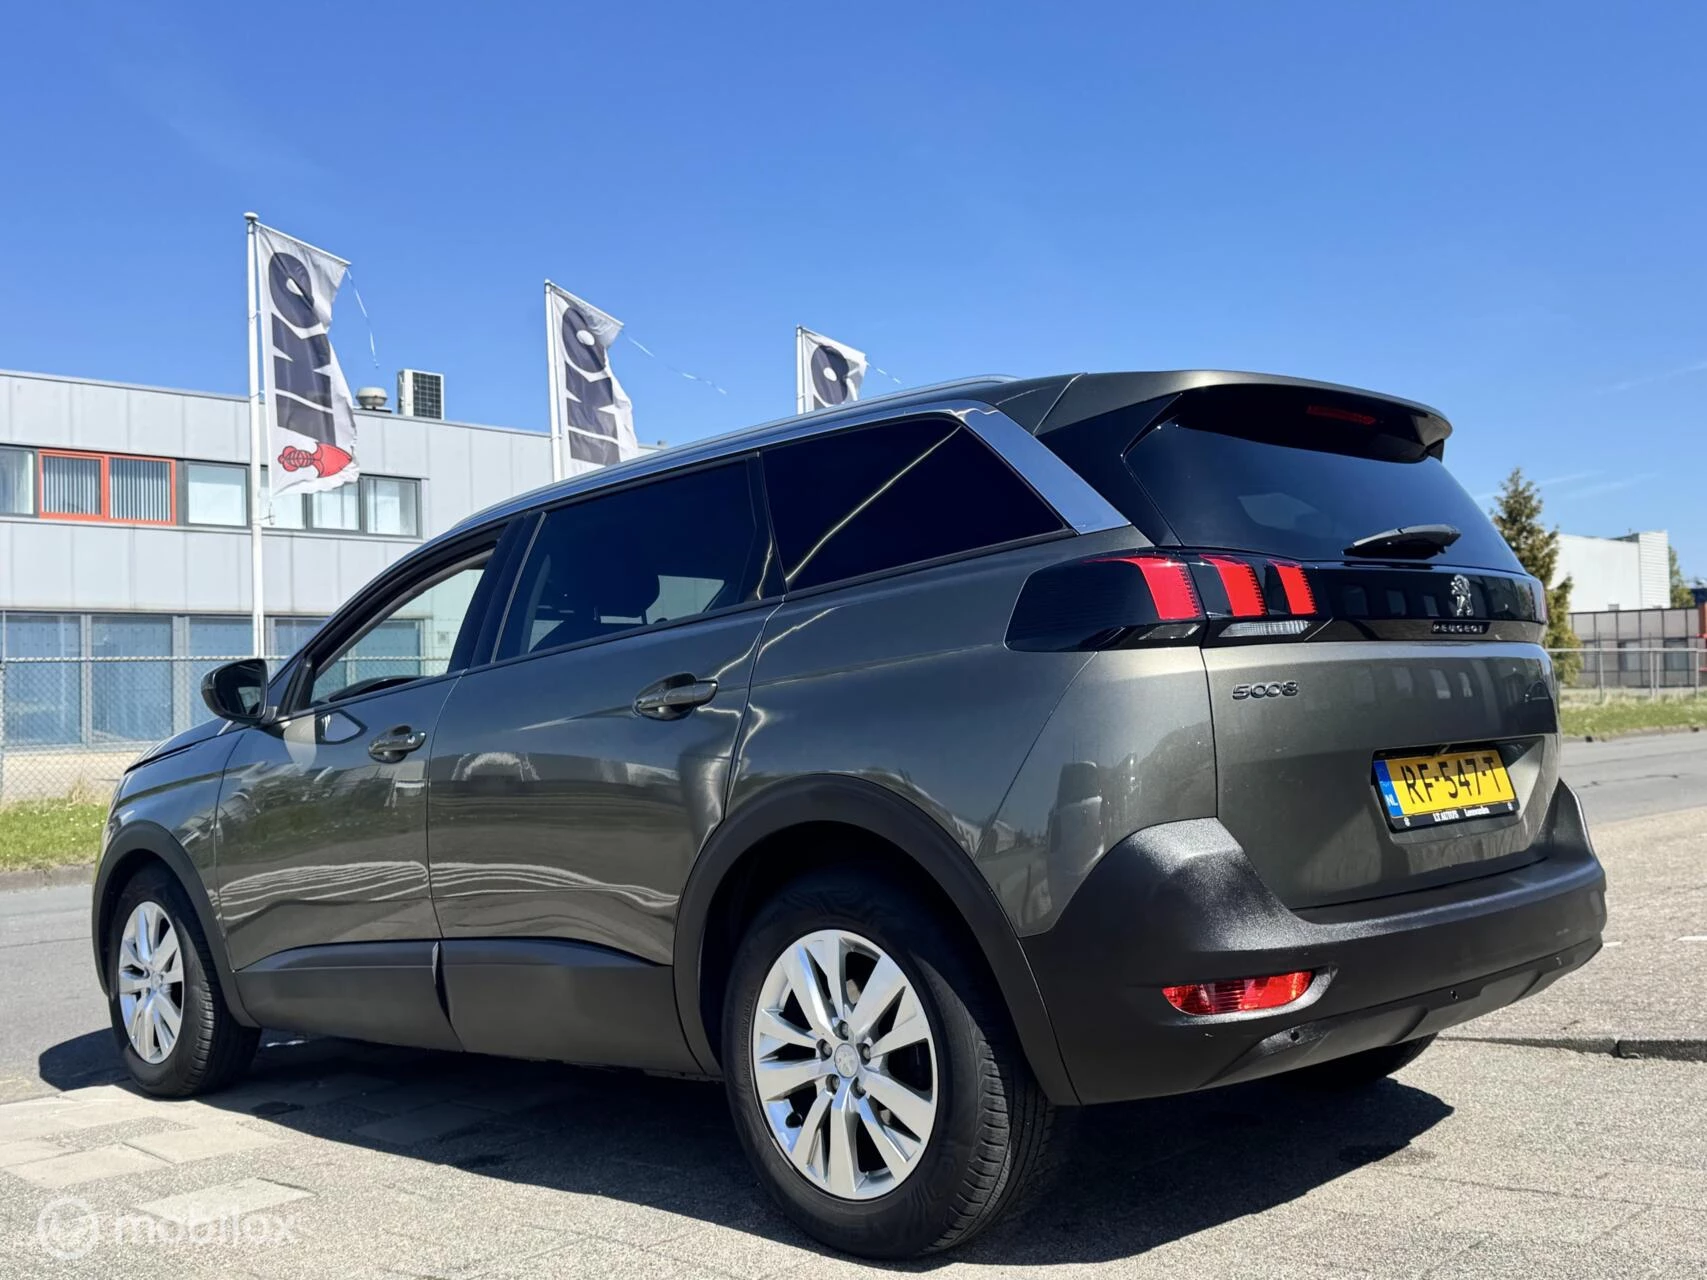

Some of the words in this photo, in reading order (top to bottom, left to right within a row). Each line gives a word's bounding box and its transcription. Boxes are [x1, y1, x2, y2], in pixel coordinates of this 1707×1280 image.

[268, 252, 336, 446] IKO
[1433, 624, 1484, 633] PEUGEOT
[1232, 680, 1300, 700] 5008
[1400, 756, 1501, 804] RF-547-T
[1384, 793, 1398, 807] NL
